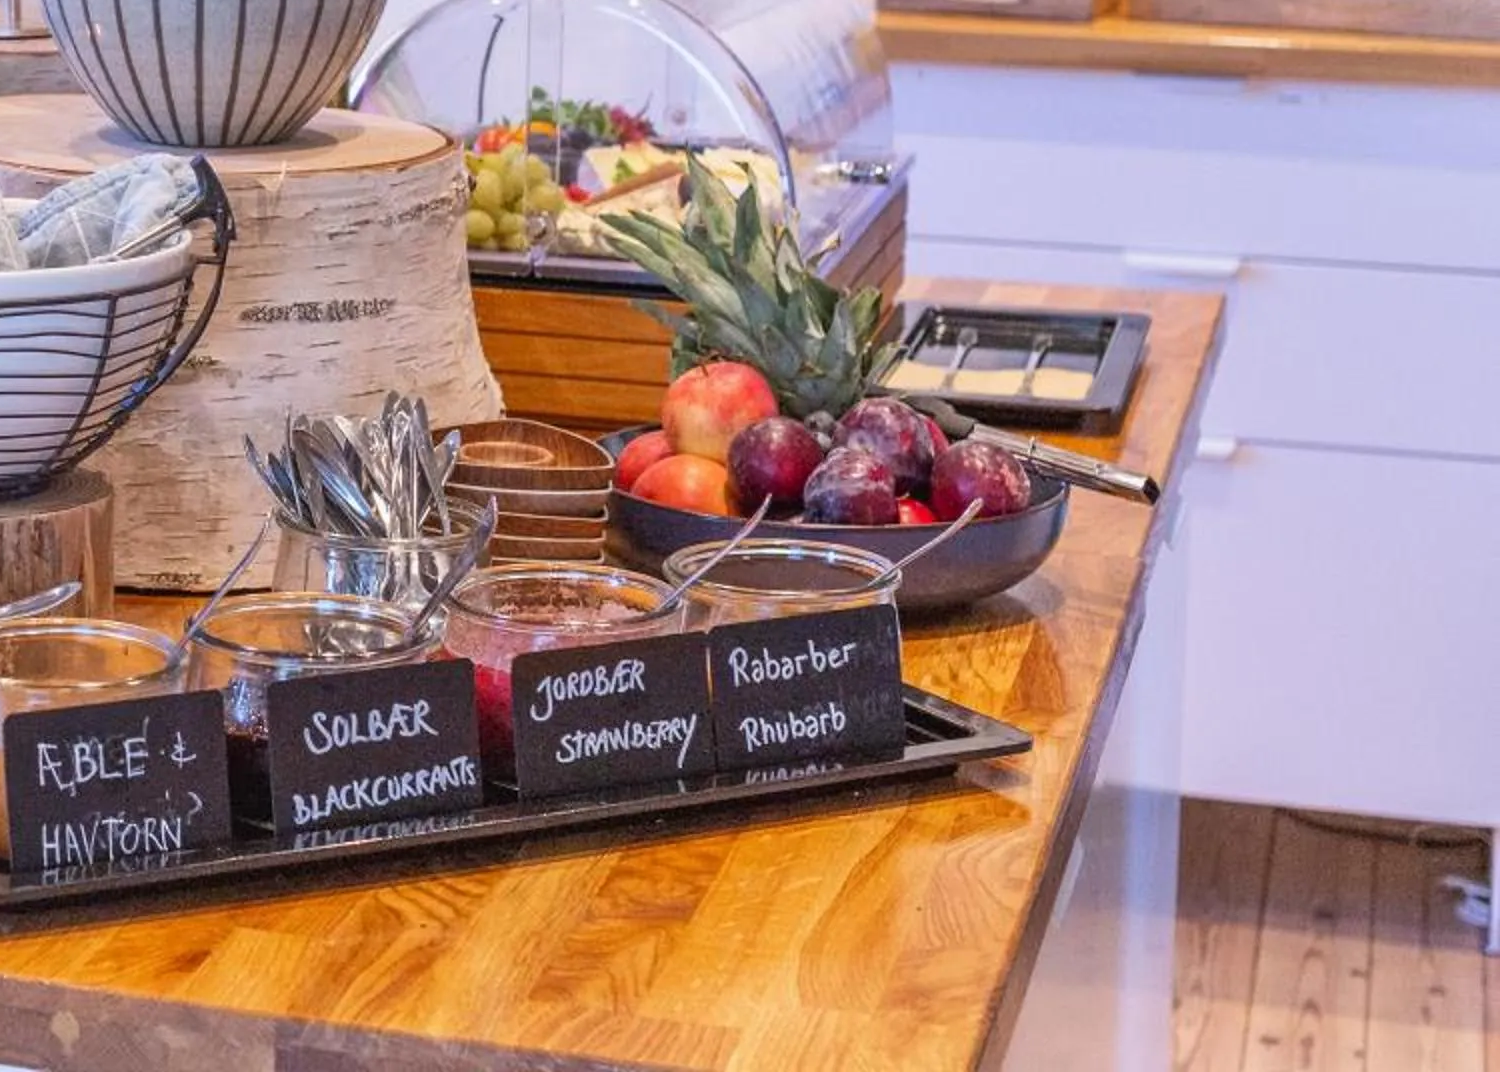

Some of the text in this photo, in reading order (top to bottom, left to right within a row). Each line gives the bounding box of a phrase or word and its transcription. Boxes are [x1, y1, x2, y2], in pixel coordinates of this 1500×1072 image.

[529, 658, 646, 722] JORDBÆR
[728, 639, 857, 688] Rabarber
[303, 699, 440, 755] SOLBÆR
[555, 713, 697, 769] STRAWBERRY
[739, 701, 847, 753] Rhubarb
[36, 737, 150, 797] ÆBLE
[292, 755, 477, 826] BLACKCURRANTS
[41, 816, 183, 868] HAVTORN
